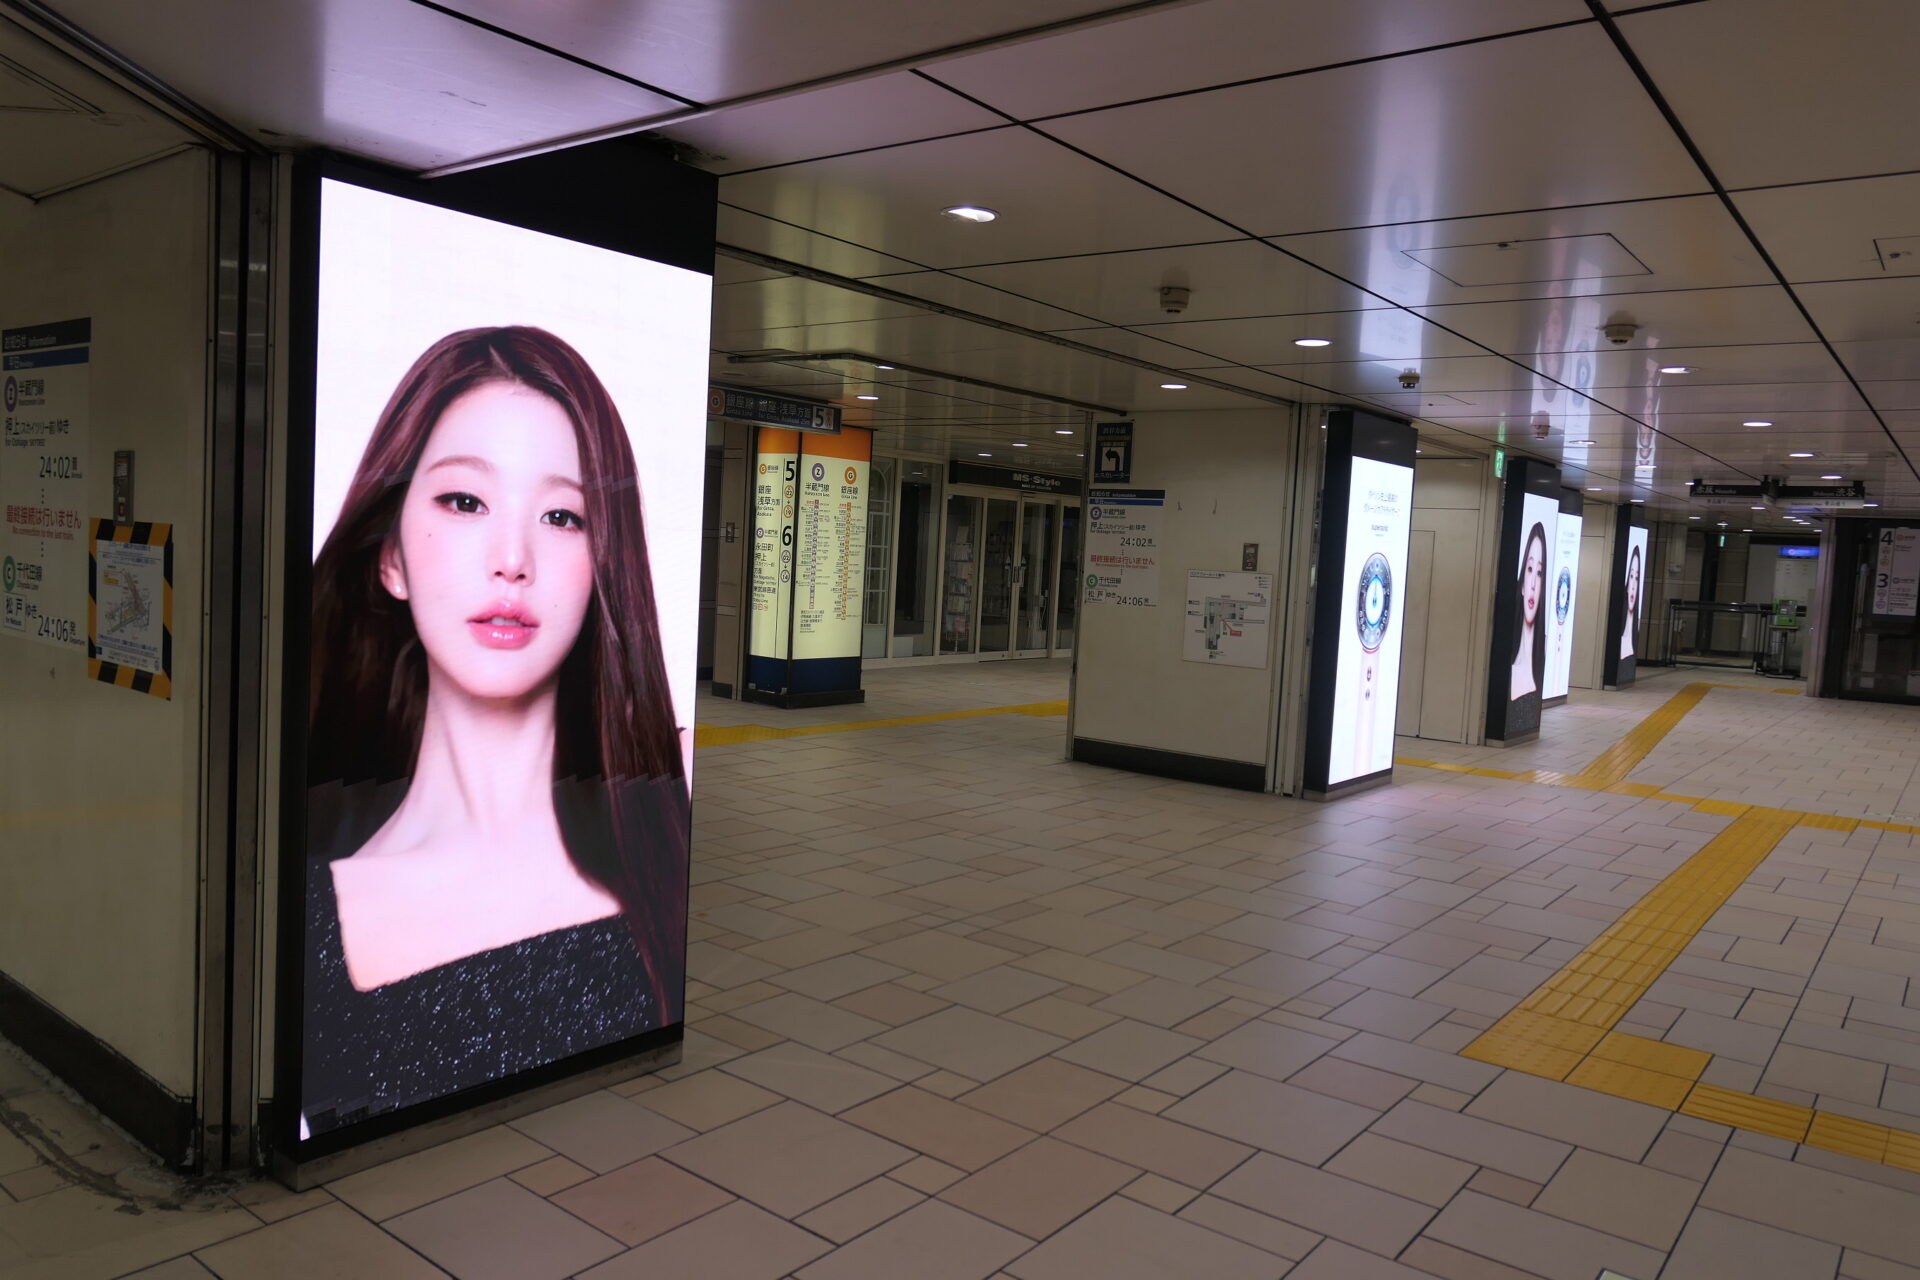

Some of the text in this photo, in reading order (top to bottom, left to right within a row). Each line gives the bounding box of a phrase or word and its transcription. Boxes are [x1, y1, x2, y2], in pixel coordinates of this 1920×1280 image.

[18, 379, 45, 396] 半蔵門線
[726, 393, 754, 409] 銀座線
[813, 407, 825, 428] 5
[40, 456, 70, 479] 24:02
[785, 460, 796, 481] 5
[805, 481, 858, 497] 半蔵門線 銀座線
[7, 504, 82, 529] 最終接続は行いません
[1102, 508, 1127, 517] 半蔵門線
[782, 525, 793, 546] 6
[1120, 537, 1147, 548] 24:02
[1881, 530, 1894, 546] 4
[1090, 554, 1155, 566] 最終接続は行いません
[16, 561, 43, 582] 千代田線
[1098, 576, 1122, 585] 千代田線
[1877, 573, 1889, 589] 3
[1116, 595, 1144, 608] 24:06
[38, 614, 69, 642] 24:06
